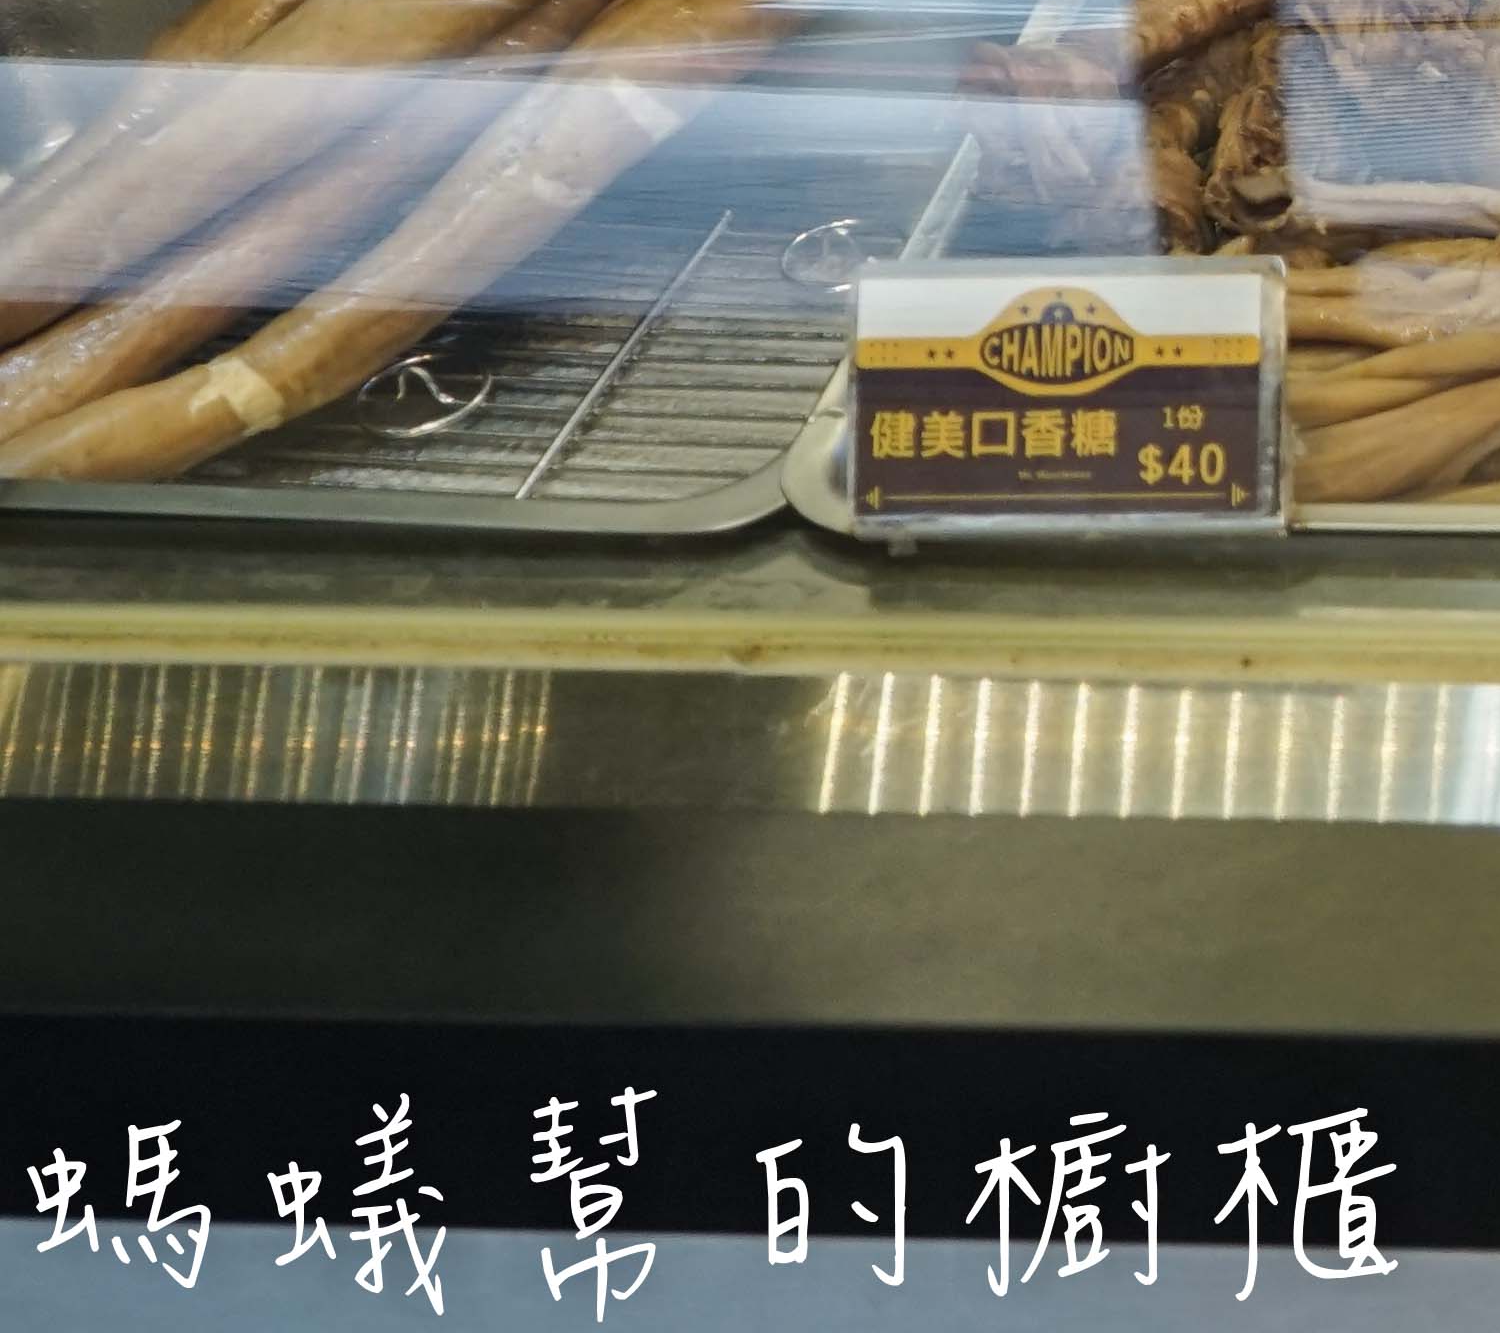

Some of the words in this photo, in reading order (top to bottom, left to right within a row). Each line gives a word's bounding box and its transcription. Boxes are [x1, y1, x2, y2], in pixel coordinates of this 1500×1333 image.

[982, 324, 1134, 380] CHAMPION
[869, 407, 1120, 460] 健美口香糖
[1137, 442, 1228, 486] $40
